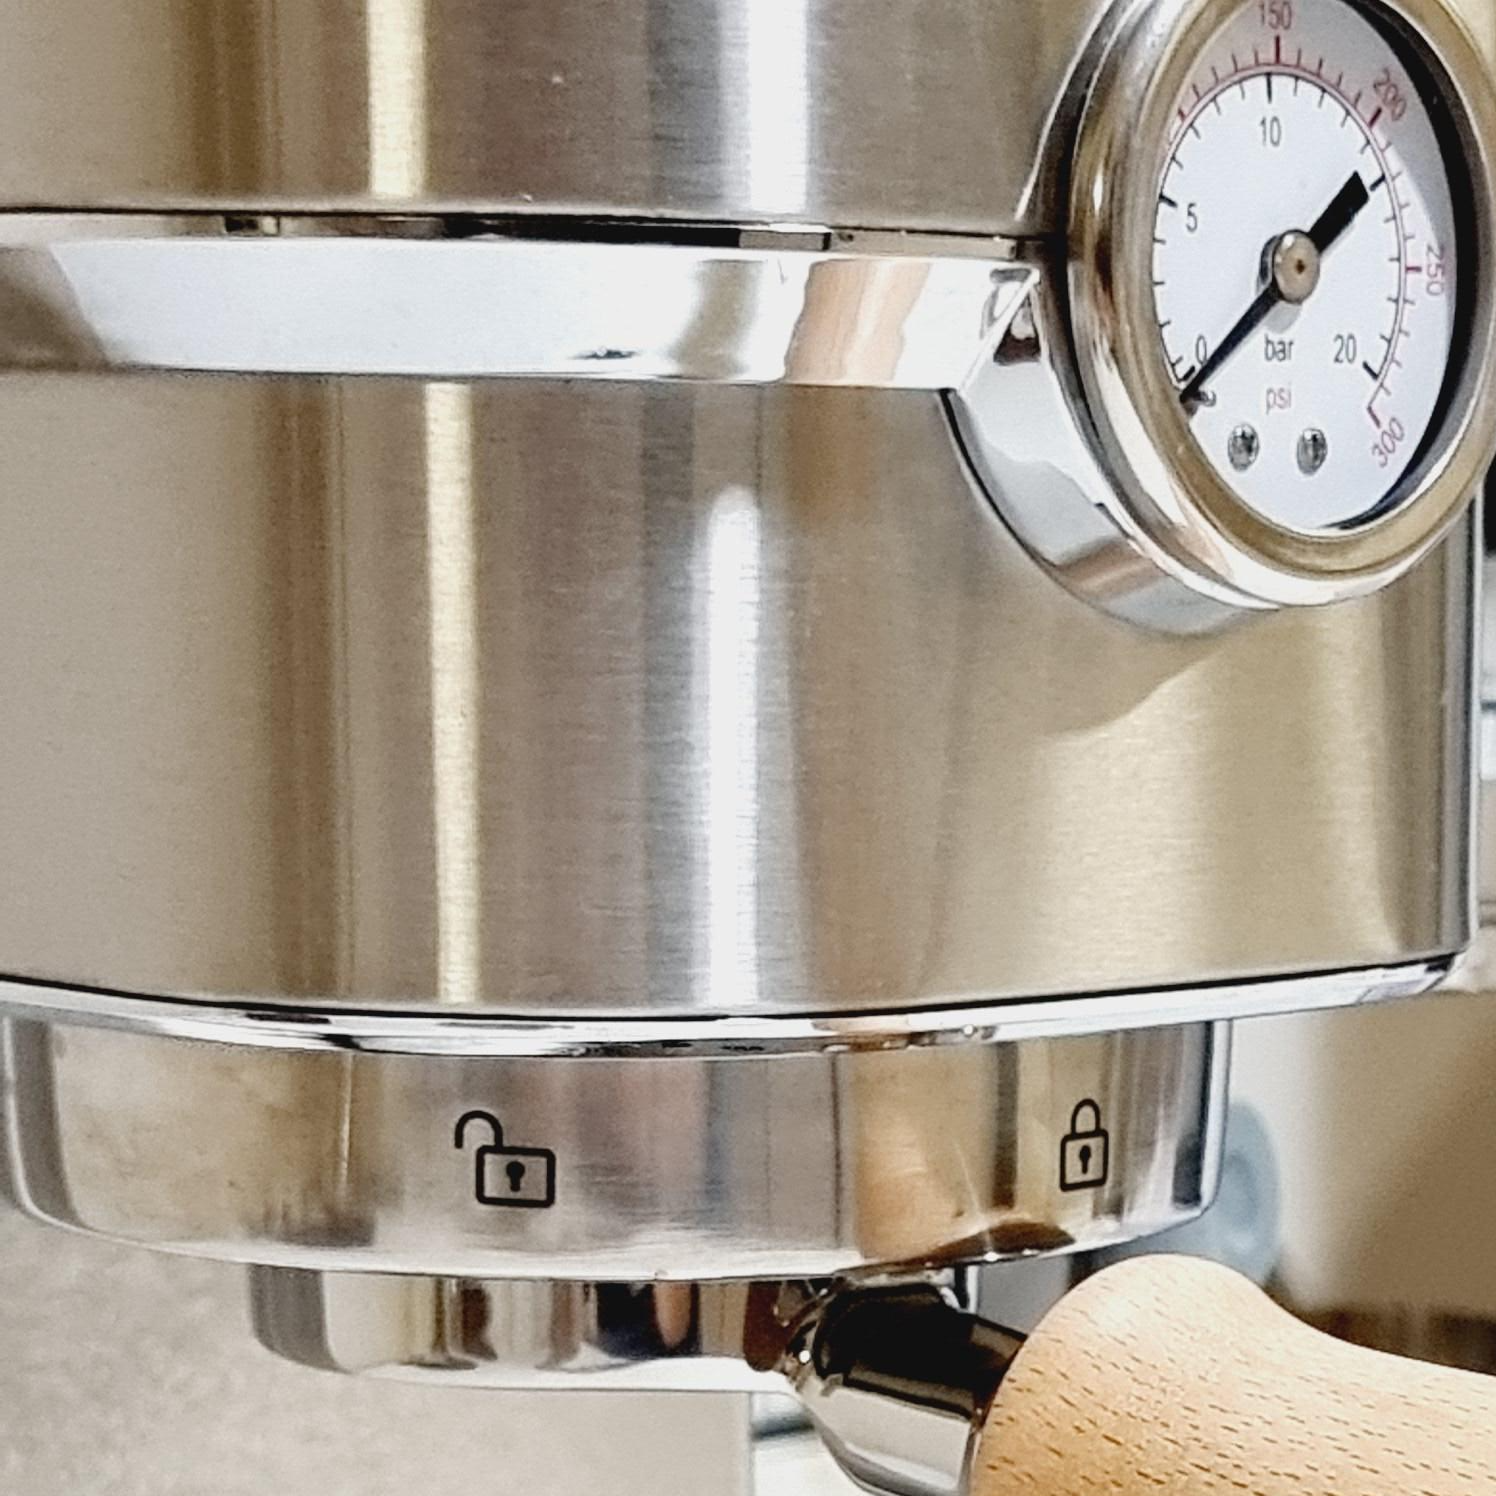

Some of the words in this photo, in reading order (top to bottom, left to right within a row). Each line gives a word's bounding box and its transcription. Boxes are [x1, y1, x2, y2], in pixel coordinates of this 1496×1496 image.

[1258, 0, 1293, 31] 150
[1372, 67, 1409, 122] 200
[1259, 115, 1283, 148] 10
[1185, 202, 1200, 234] 5
[1425, 244, 1446, 298] 250
[1194, 333, 1208, 367] 0
[1264, 333, 1295, 363] bar
[1333, 332, 1358, 365] 20
[1265, 382, 1293, 415] psi
[1371, 416, 1407, 469] 300
